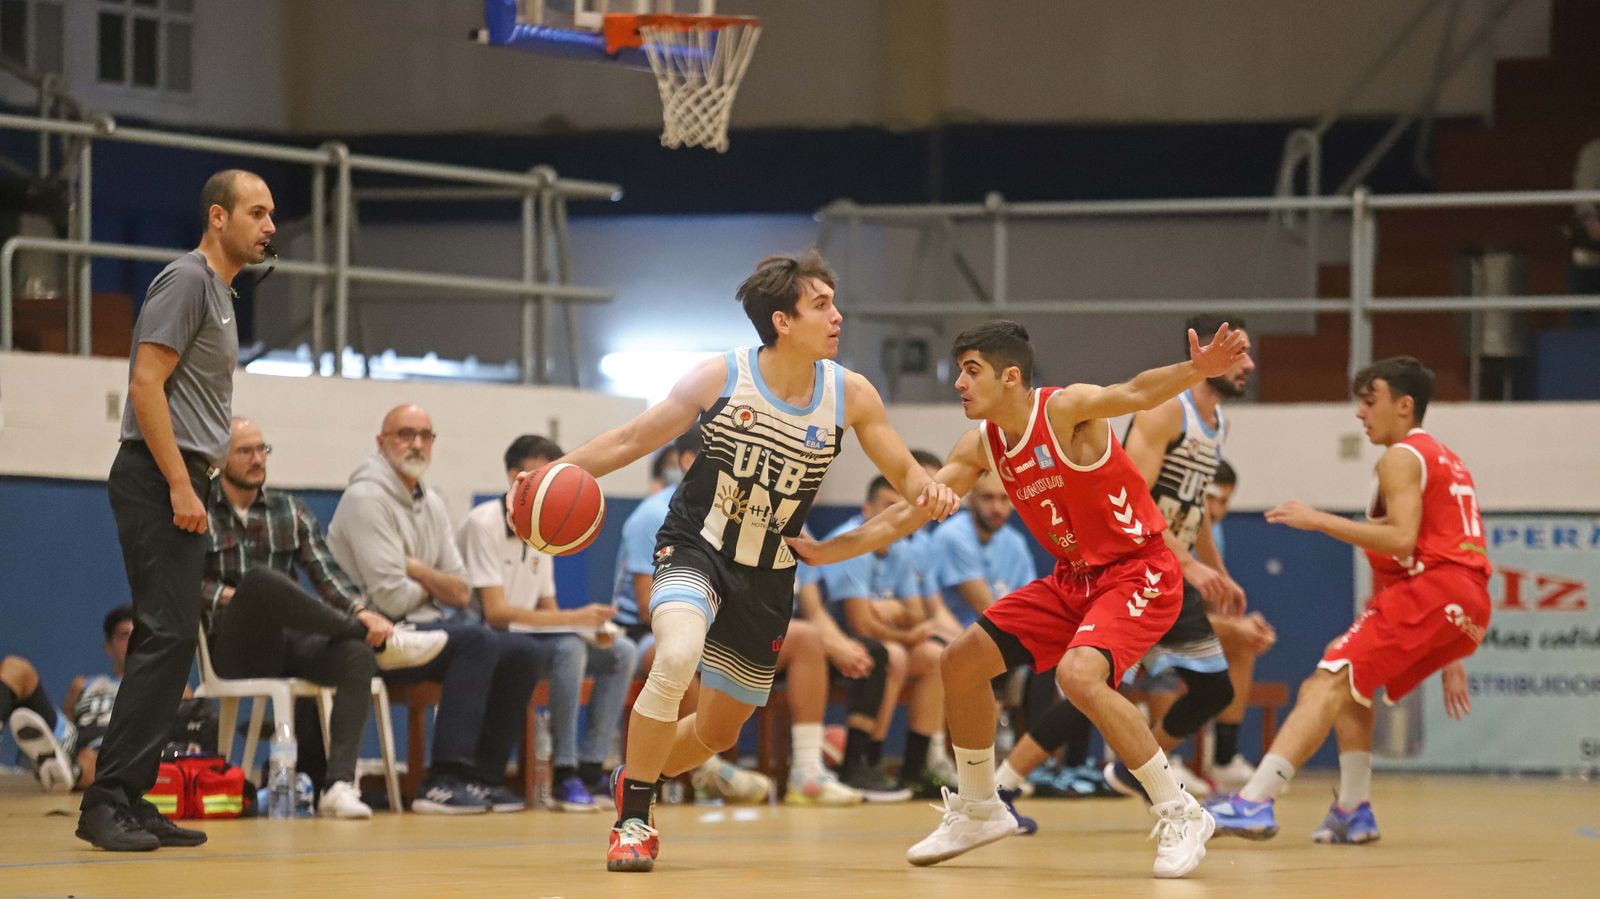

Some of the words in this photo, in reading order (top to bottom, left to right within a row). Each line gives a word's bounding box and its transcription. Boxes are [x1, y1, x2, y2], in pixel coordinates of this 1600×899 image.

[805, 439, 820, 449] EBA
[1040, 499, 1063, 526] 2
[1448, 482, 1481, 538] 17
